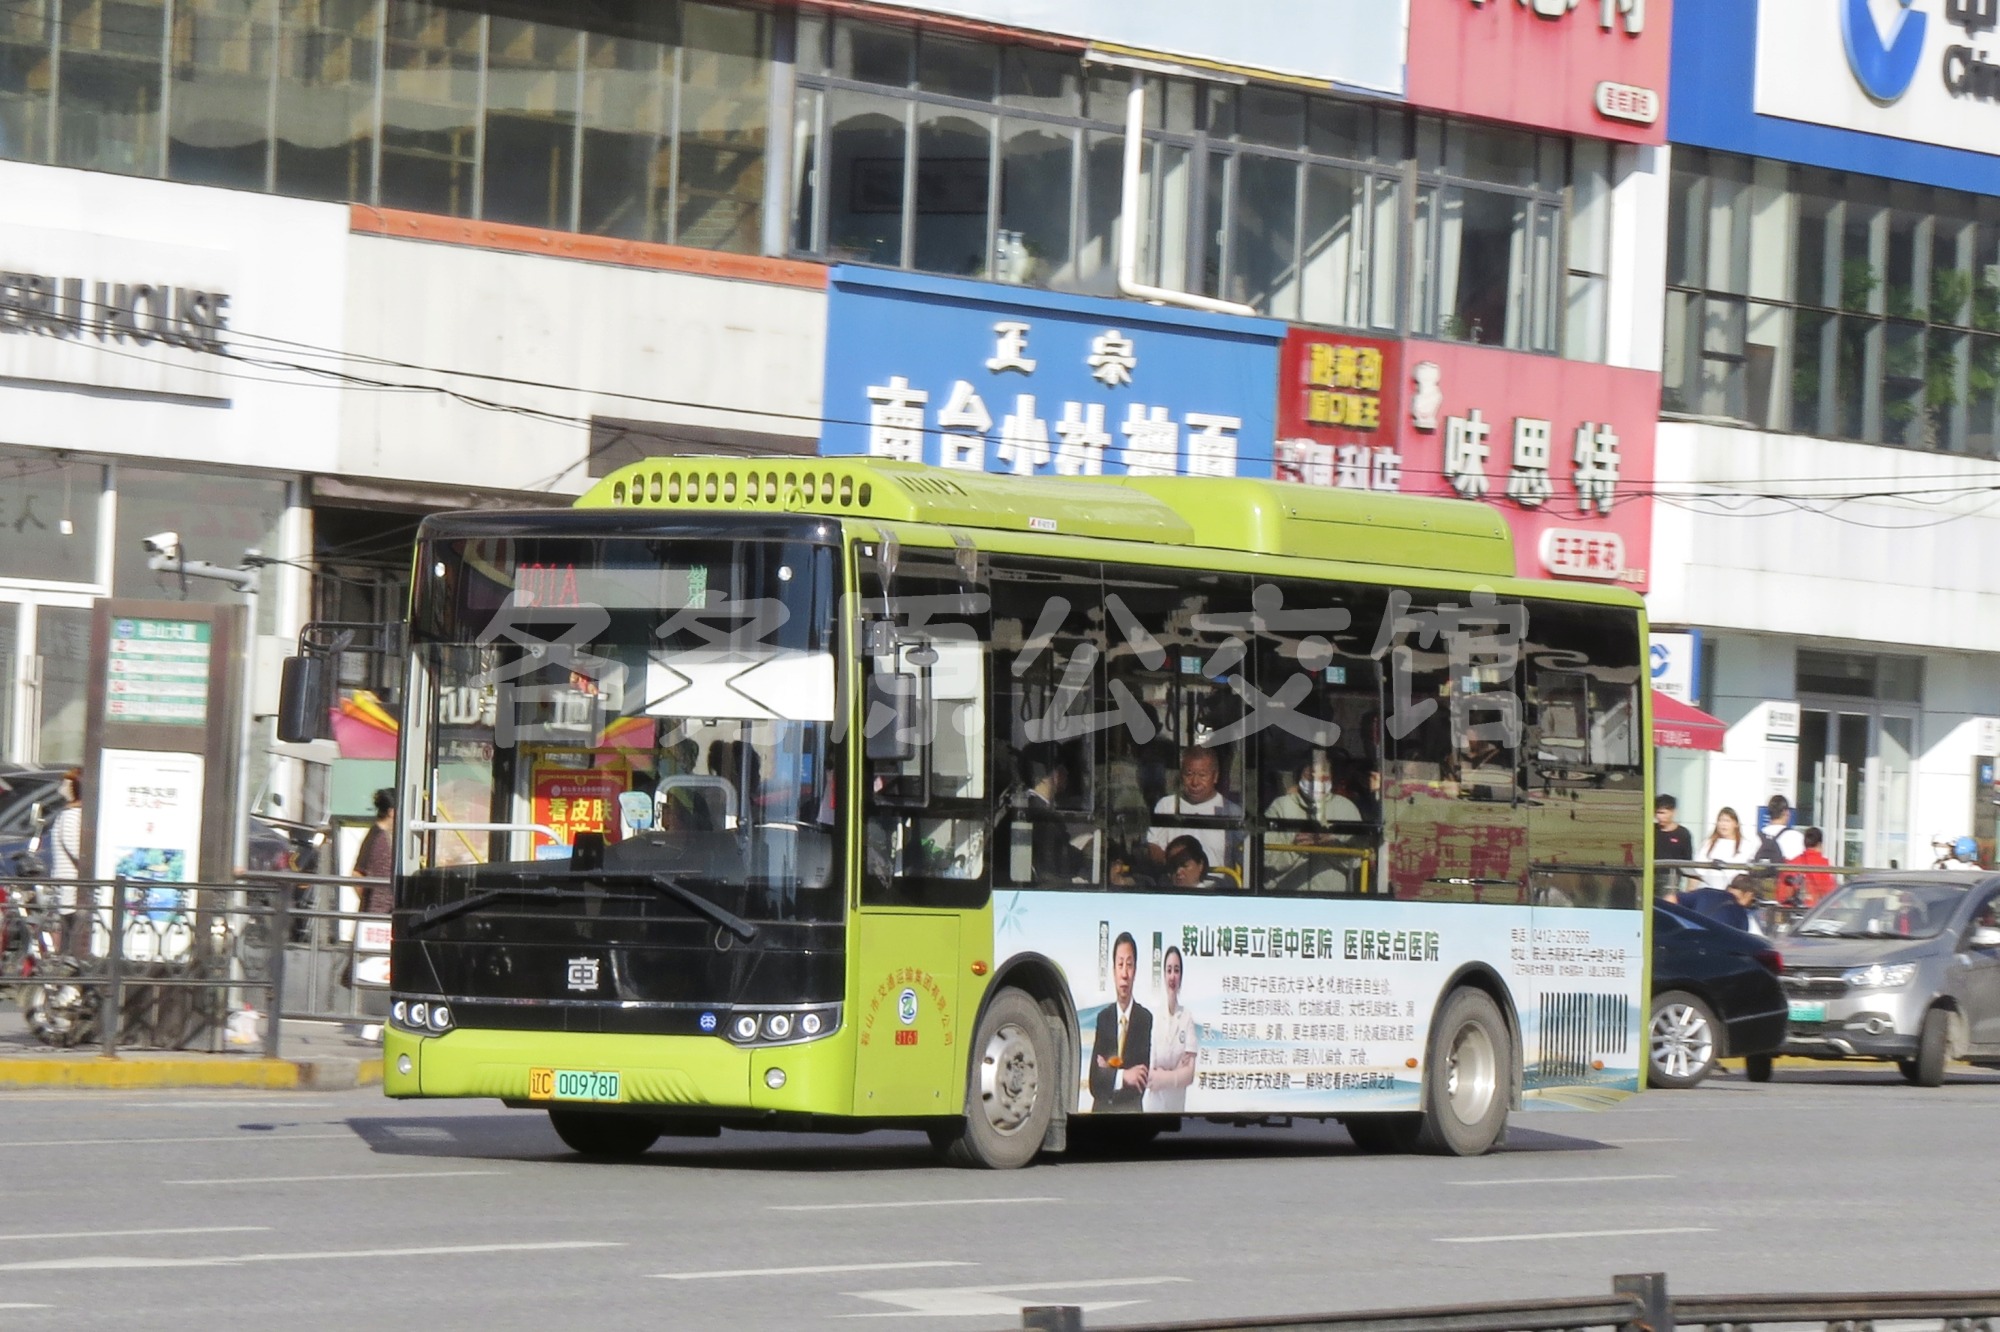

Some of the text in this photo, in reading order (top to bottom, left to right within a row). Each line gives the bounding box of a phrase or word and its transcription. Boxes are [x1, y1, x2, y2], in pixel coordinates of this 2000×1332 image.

[94, 281, 231, 354] HOUSE
[985, 321, 1138, 387] 正宗
[1444, 408, 1621, 515] 味思特
[548, 797, 613, 822] 看皮肤
[1181, 925, 1440, 962] 鞍山神草立德中医院 医保定点医院
